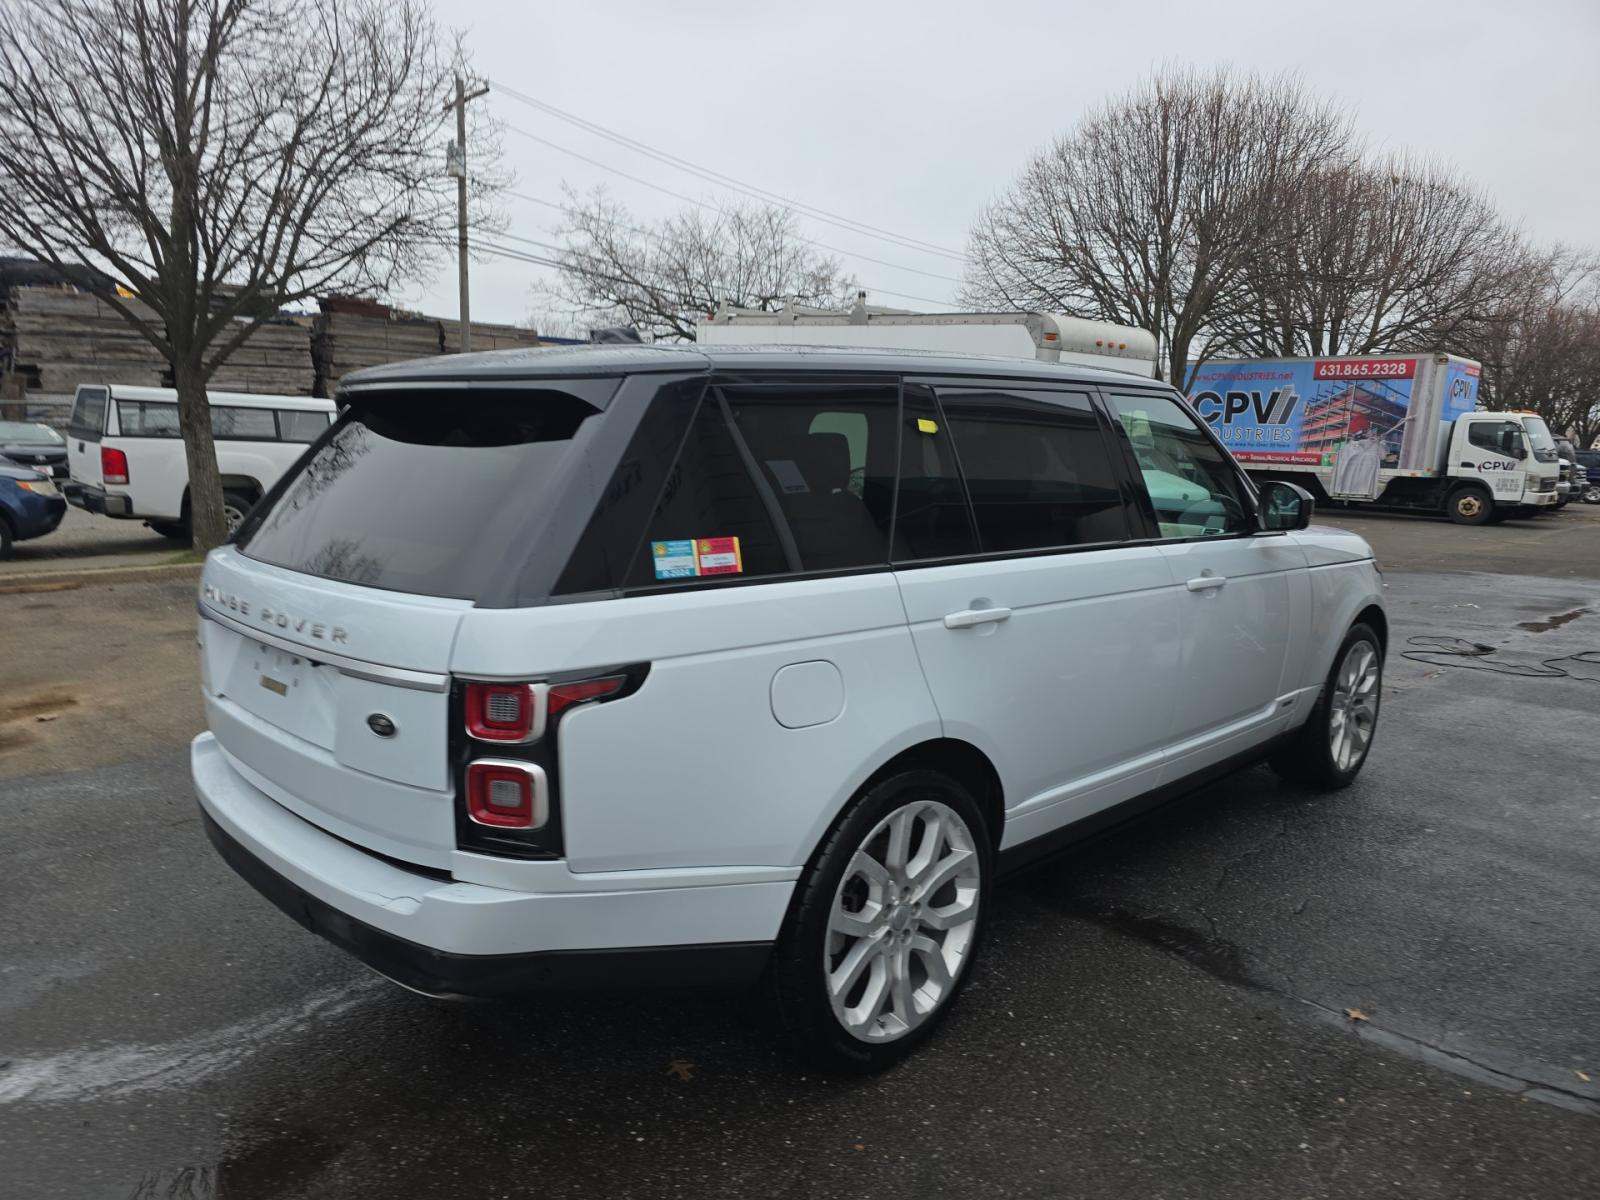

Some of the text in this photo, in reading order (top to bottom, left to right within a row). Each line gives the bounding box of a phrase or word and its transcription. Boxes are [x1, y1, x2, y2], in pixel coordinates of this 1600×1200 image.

[1319, 362, 1407, 377] 631.865.2328
[1192, 391, 1283, 425] CPV
[1212, 427, 1294, 442] DUSTRIES
[1482, 461, 1510, 471] CPV
[261, 607, 351, 645] ROVER
